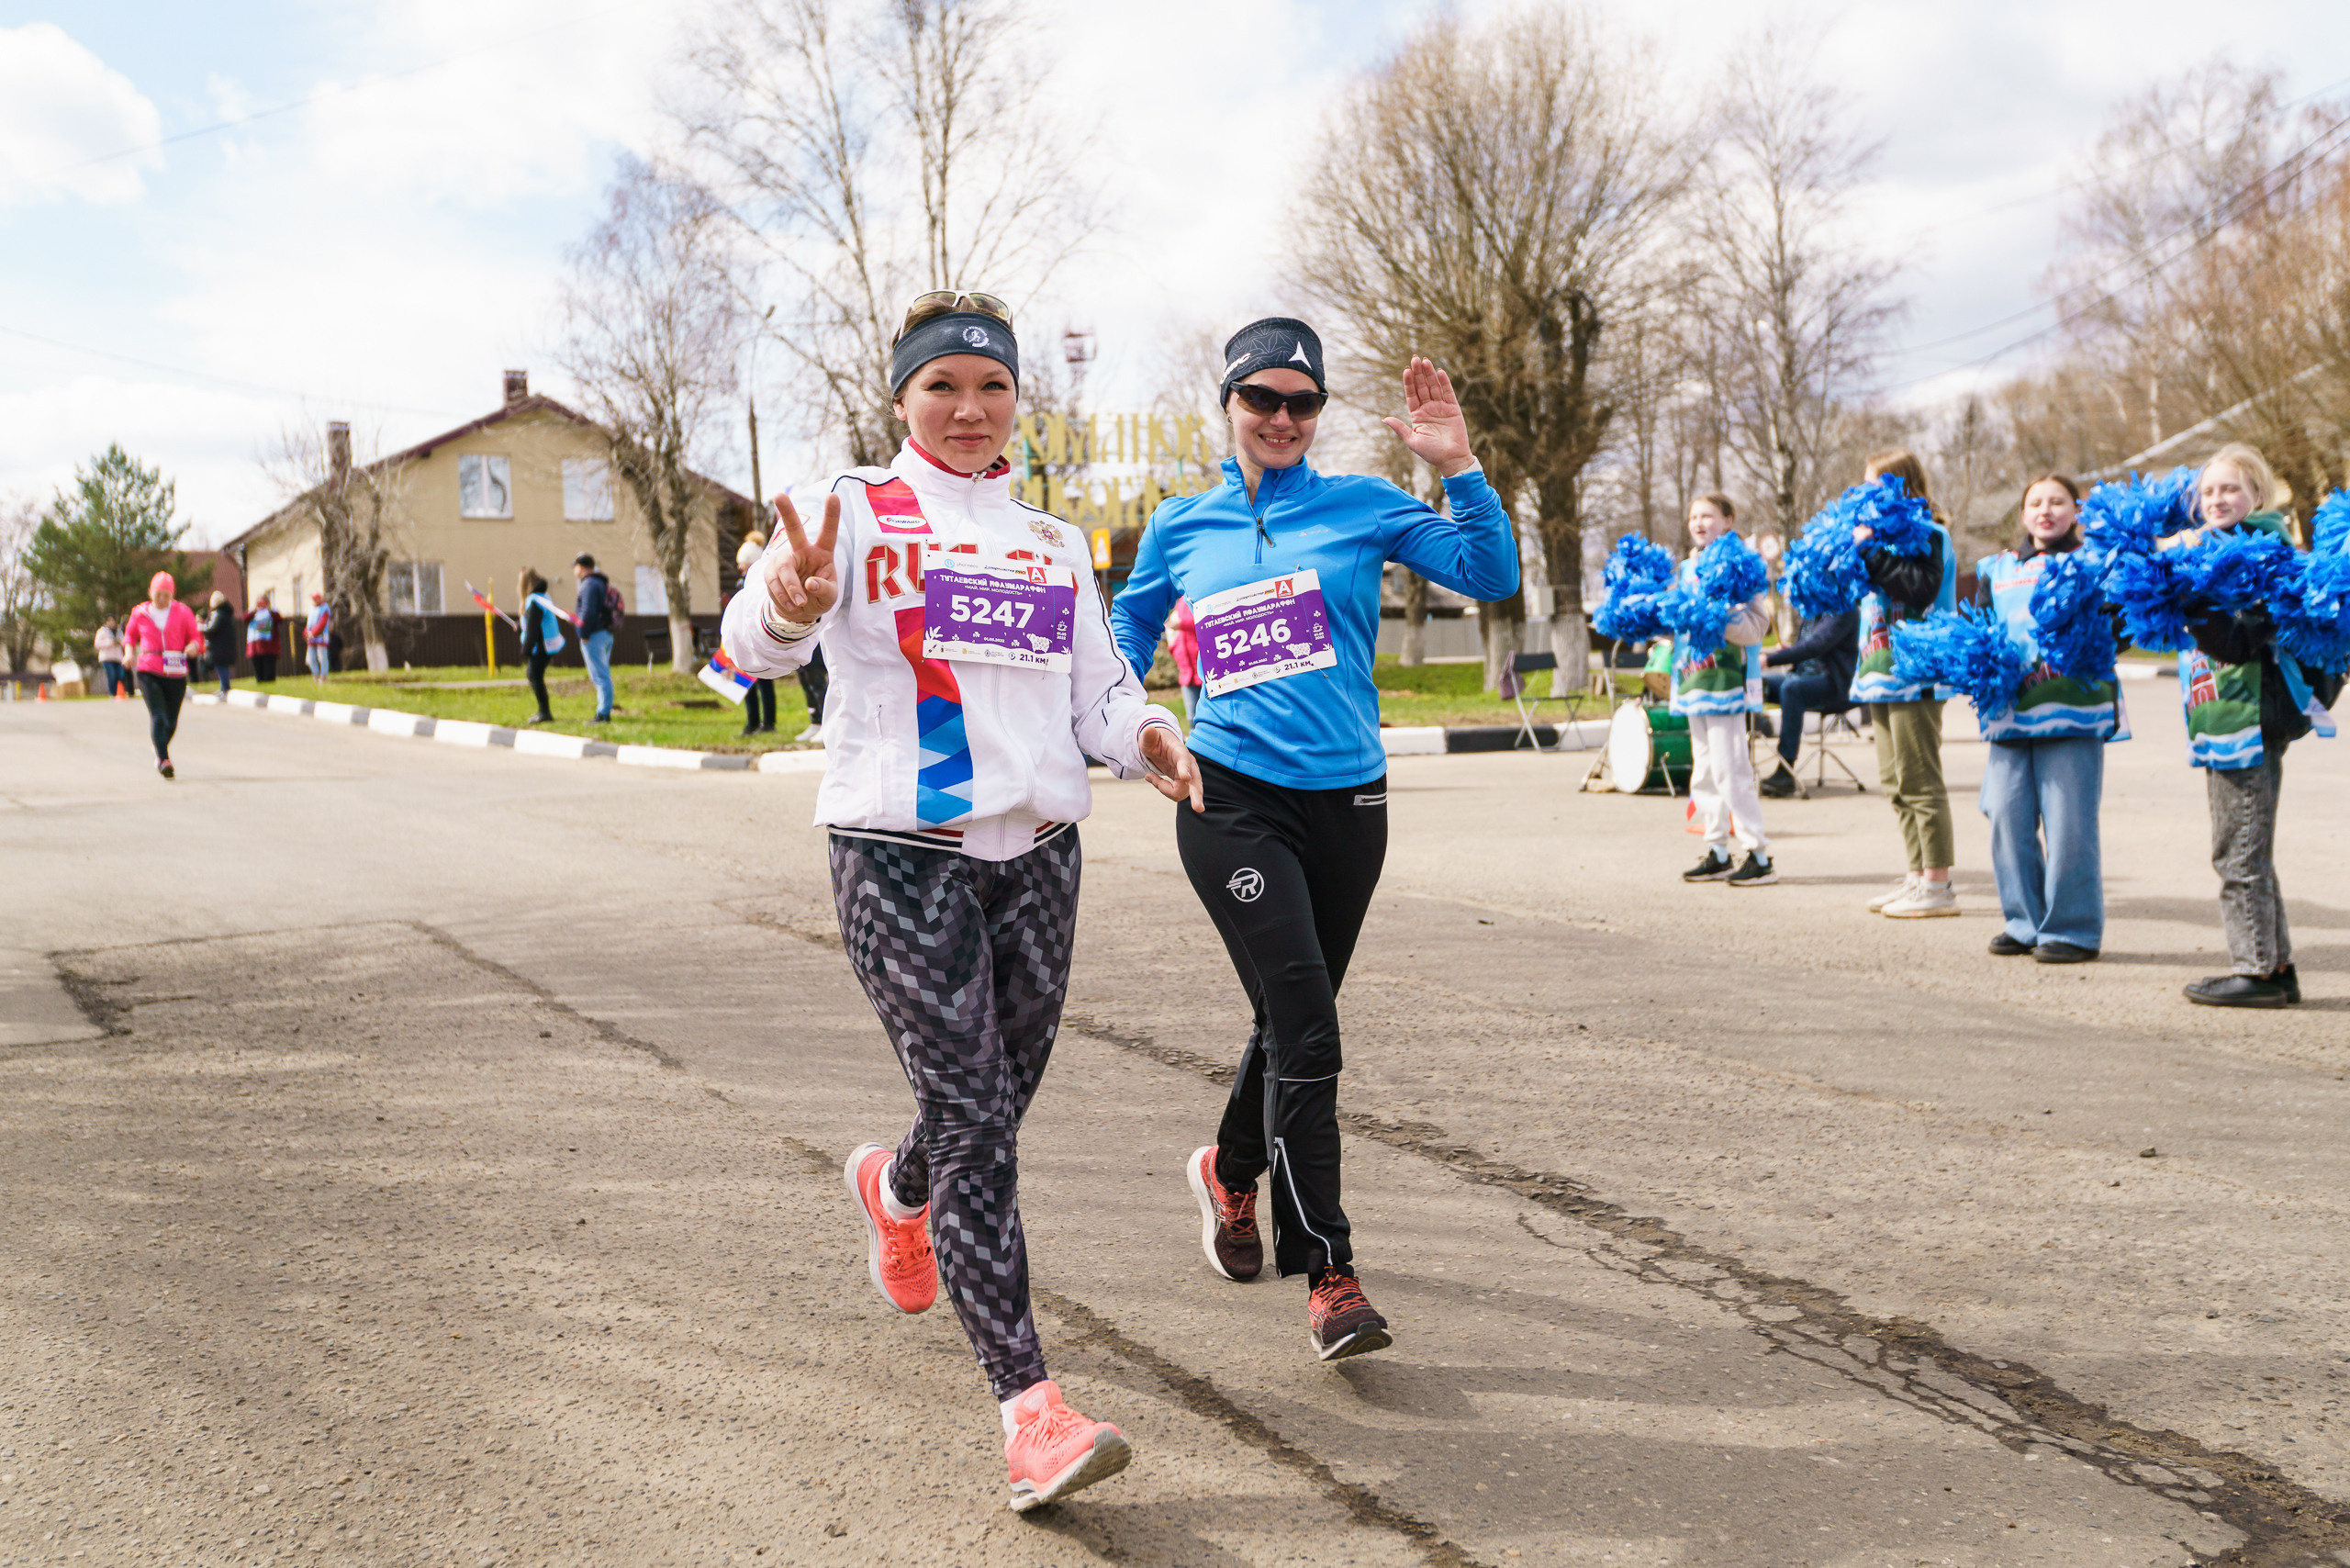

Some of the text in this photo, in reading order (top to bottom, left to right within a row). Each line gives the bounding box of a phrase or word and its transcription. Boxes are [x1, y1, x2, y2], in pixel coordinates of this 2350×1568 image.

[940, 574, 1046, 594] ТУТАЕВСКИЙ ПОЛУМАРАФОН
[949, 594, 1035, 629] 5247
[1204, 599, 1296, 629] ТУТАЕВСКИЙ ПОЛУМАРАФОН
[1214, 618, 1292, 659] 5246
[1019, 653, 1034, 663] 21.1
[1283, 662, 1299, 671] 21.1
